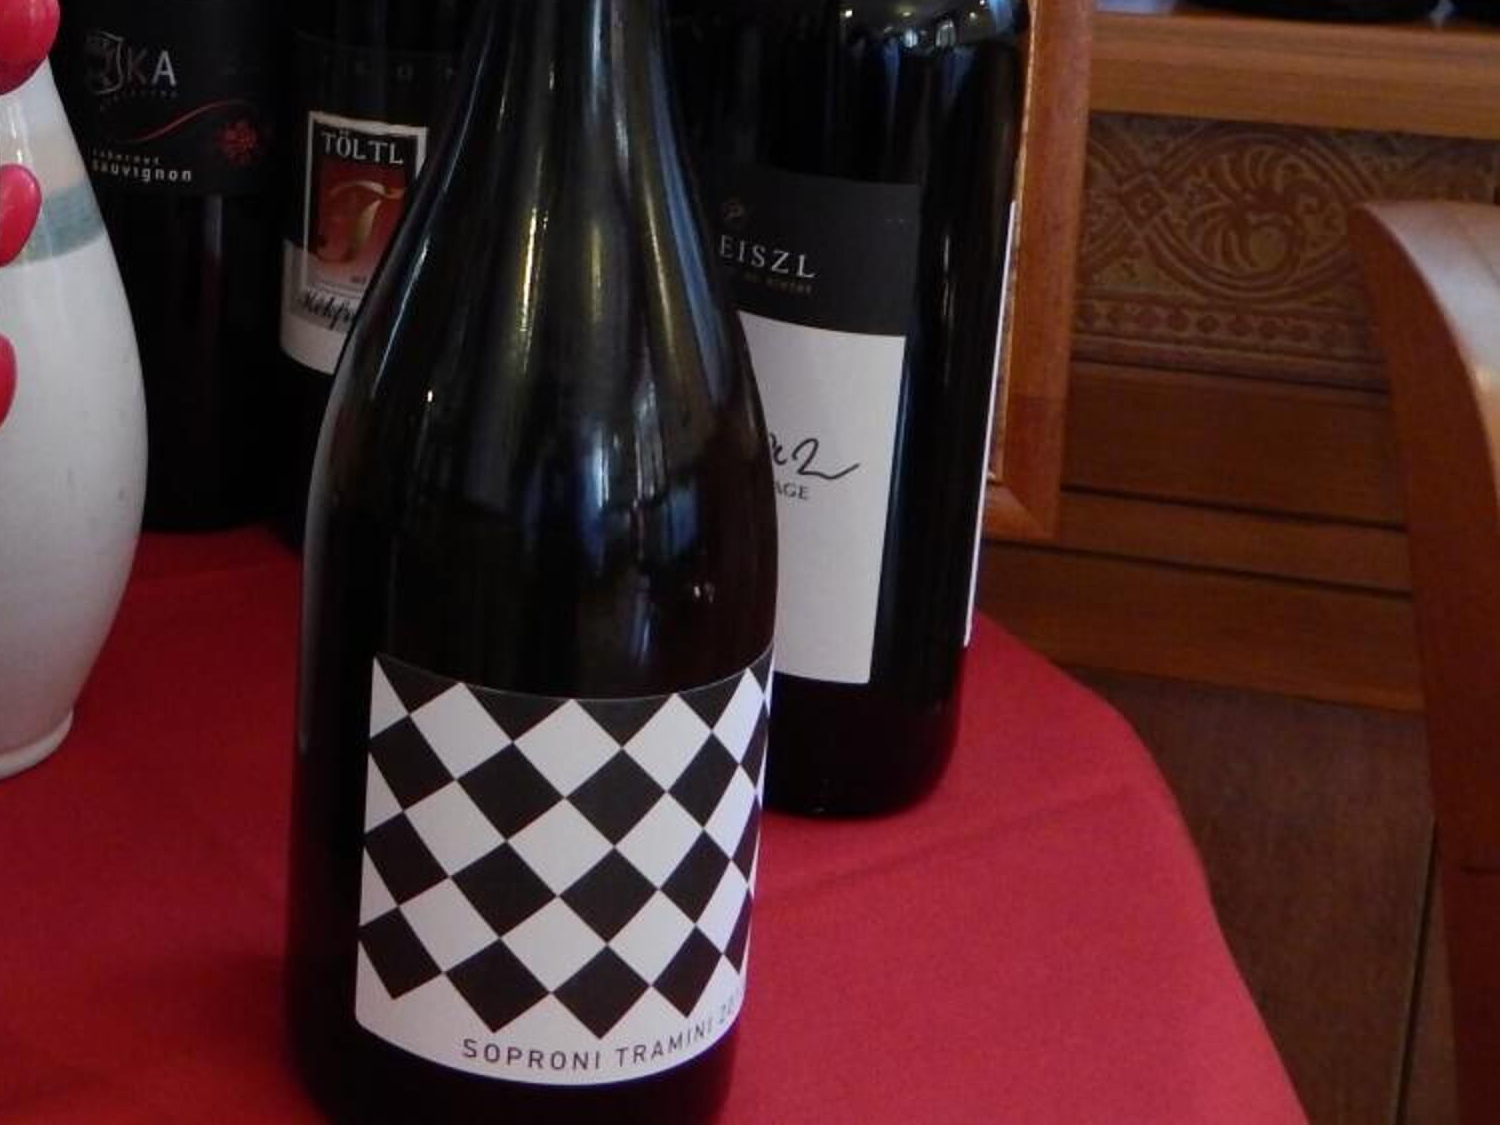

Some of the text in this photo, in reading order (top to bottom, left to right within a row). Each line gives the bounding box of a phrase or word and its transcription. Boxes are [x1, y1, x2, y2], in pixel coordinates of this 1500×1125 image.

[320, 130, 405, 164] TÖLTL
[719, 234, 817, 279] EISZL
[462, 1037, 601, 1071] SOPRONI
[615, 1018, 713, 1068] TRAMINI
